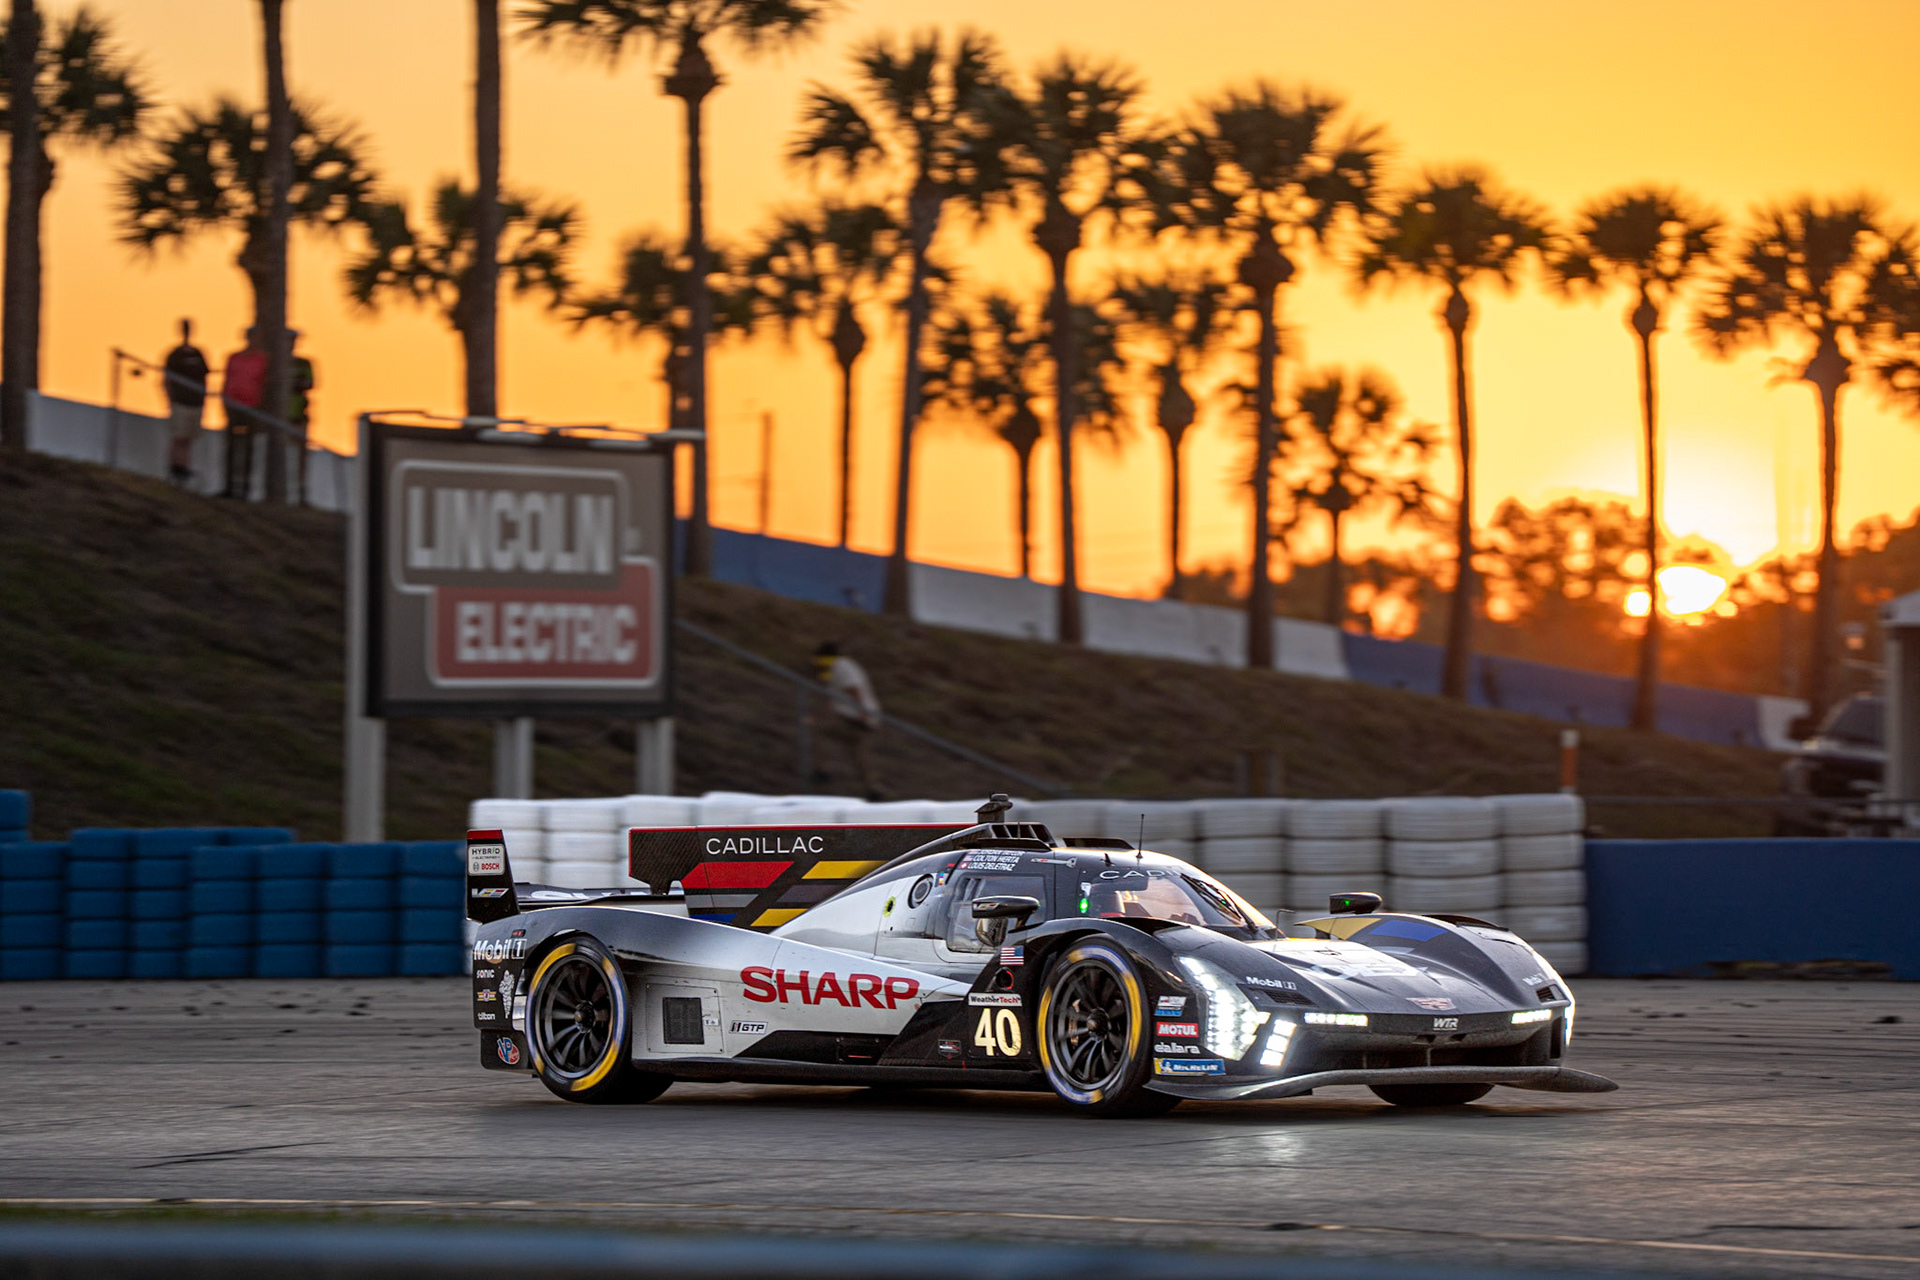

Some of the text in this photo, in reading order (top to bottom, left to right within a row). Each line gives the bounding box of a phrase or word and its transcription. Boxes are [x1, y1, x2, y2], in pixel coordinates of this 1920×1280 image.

[406, 486, 614, 575] LINCOLN
[456, 602, 637, 664] ELECTRIC
[472, 847, 501, 855] HYBRID
[706, 836, 824, 855] CADILLAC
[474, 940, 513, 960] Mobil
[476, 969, 495, 979] sonic
[740, 966, 920, 1010] SHARP
[1246, 976, 1283, 988] Mobil
[971, 995, 1019, 1003] WeatherTech
[741, 1023, 765, 1032] GTP
[1434, 1018, 1458, 1028] WTR
[974, 1008, 1022, 1056] 40
[1158, 1024, 1197, 1035] MOTUL
[1154, 1042, 1201, 1054] dallara
[1173, 1063, 1219, 1071] MICHELIN
